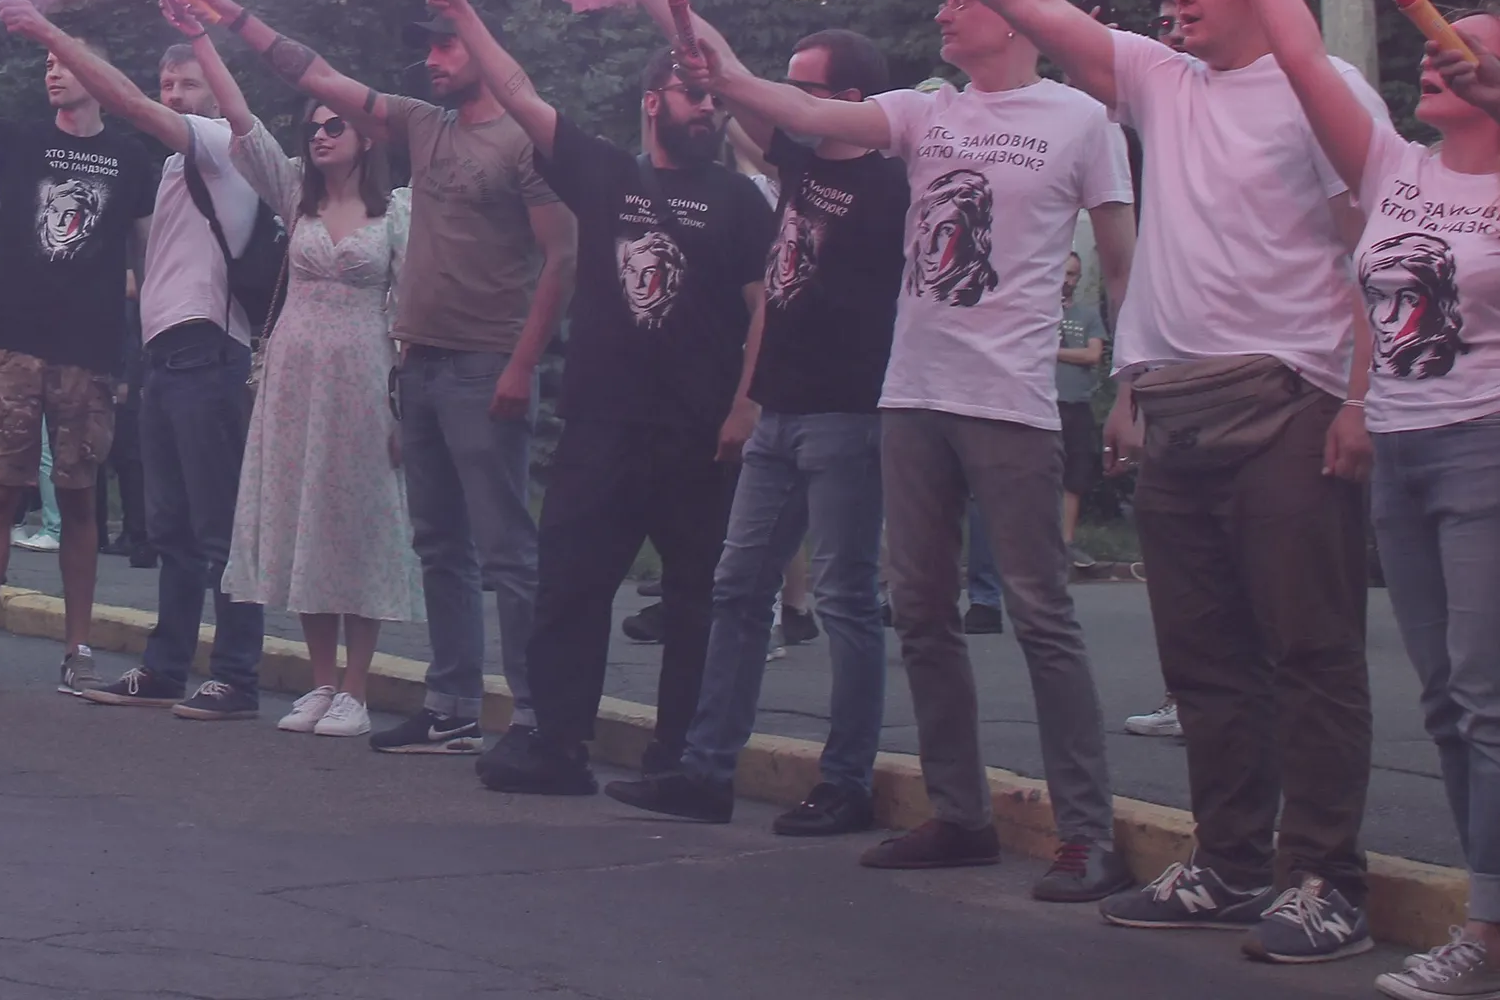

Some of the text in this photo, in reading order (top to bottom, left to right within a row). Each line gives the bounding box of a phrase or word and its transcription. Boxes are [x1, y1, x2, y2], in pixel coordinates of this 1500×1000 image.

[960, 133, 1049, 154] ЗАМОВИВ
[44, 149, 118, 167] ХТО ЗАМОВИВ
[957, 150, 1045, 172] ГАНДЗЮК?
[49, 161, 119, 177] АТЮ ГАНДЗЮК?
[1395, 179, 1420, 200] ТО
[624, 194, 651, 209] WHO
[1176, 885, 1217, 913] N
[1322, 912, 1352, 943] N
